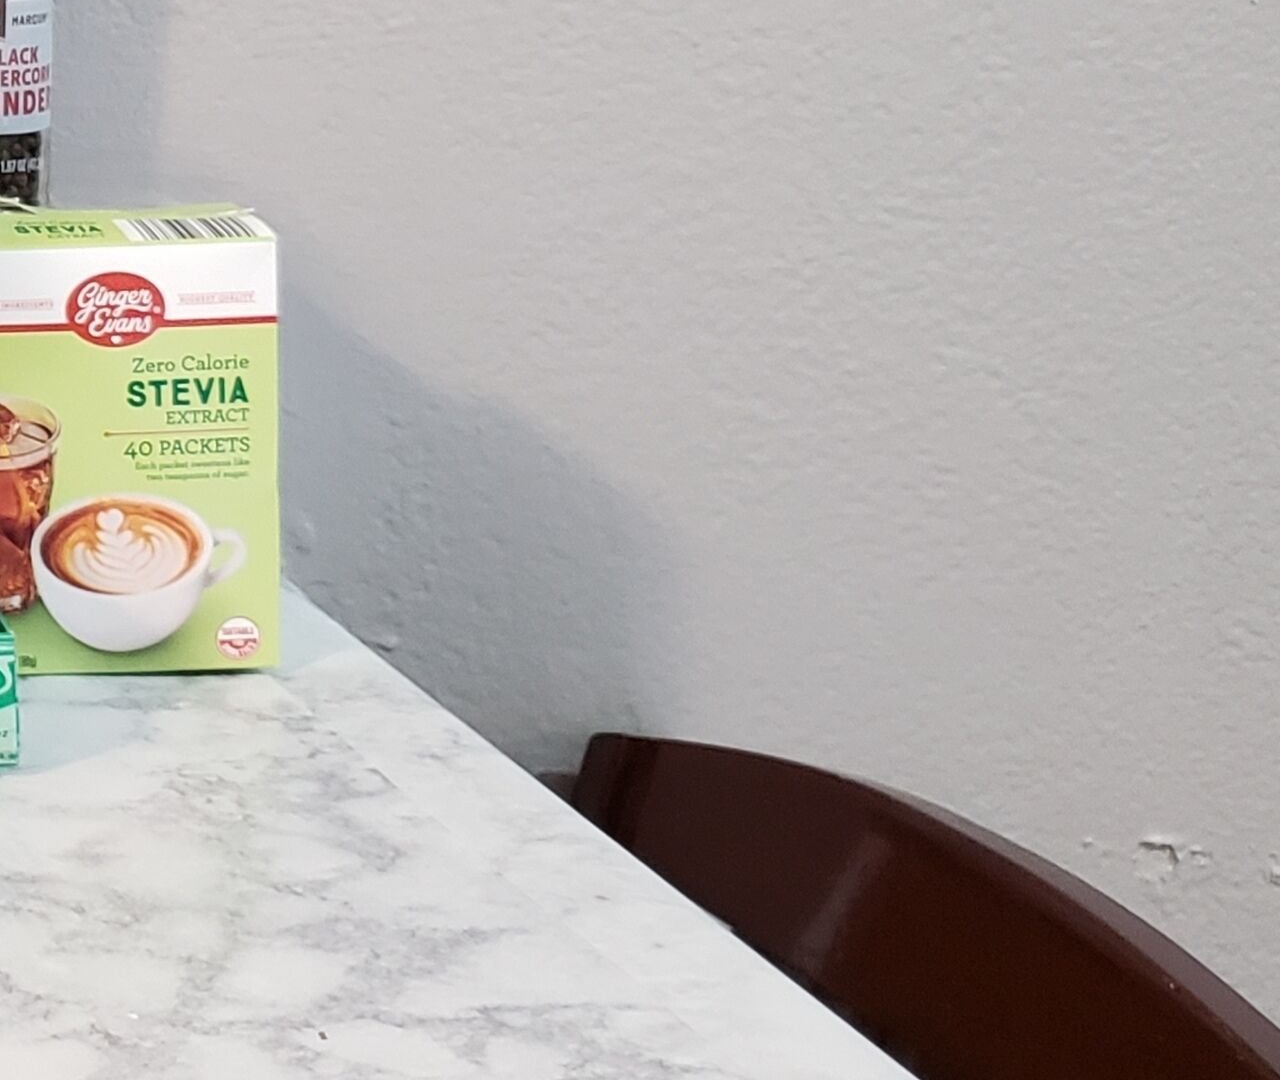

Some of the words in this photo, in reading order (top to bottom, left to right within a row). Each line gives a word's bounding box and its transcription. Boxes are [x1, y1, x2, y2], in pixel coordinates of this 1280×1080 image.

[14, 225, 102, 234] STEVIA
[74, 281, 153, 324] Ginger
[88, 307, 152, 337] Evans
[132, 357, 175, 373] Zero
[181, 353, 250, 371] Calorie
[126, 375, 249, 407] STEVIA
[166, 407, 250, 425] EXTRACT
[123, 441, 153, 460] 40
[159, 436, 250, 456] PACKETS
